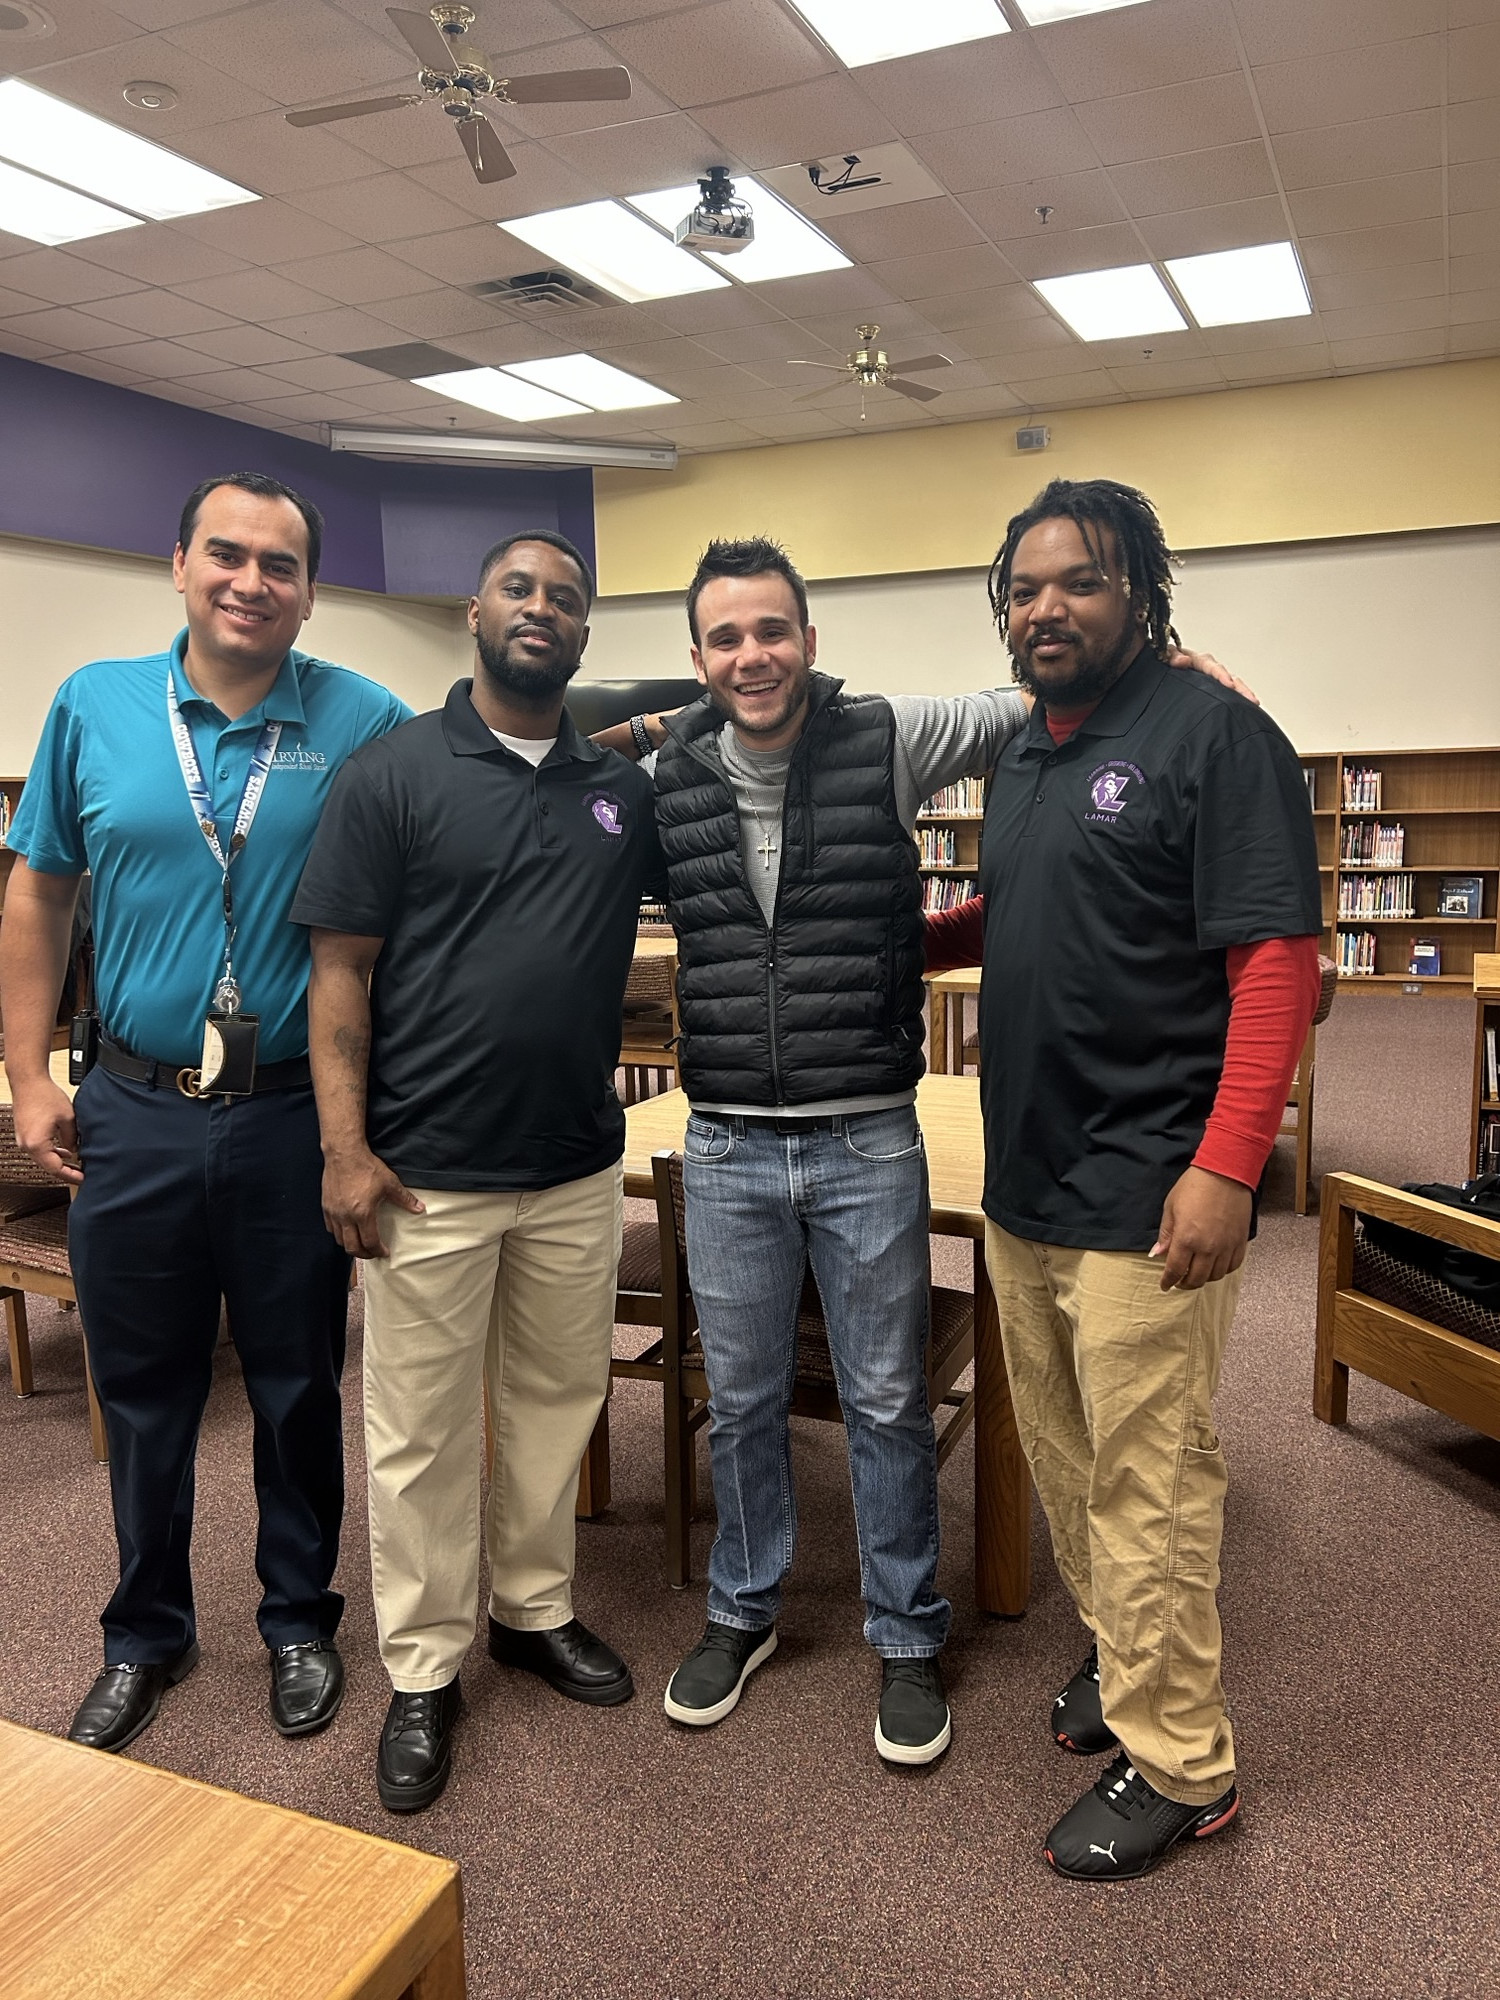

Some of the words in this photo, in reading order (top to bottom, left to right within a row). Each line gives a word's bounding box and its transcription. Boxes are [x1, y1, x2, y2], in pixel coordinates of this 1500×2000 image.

[177, 723, 201, 783] COWBOYS
[272, 752, 326, 763] IRVING
[1084, 812, 1117, 823] LAMAR
